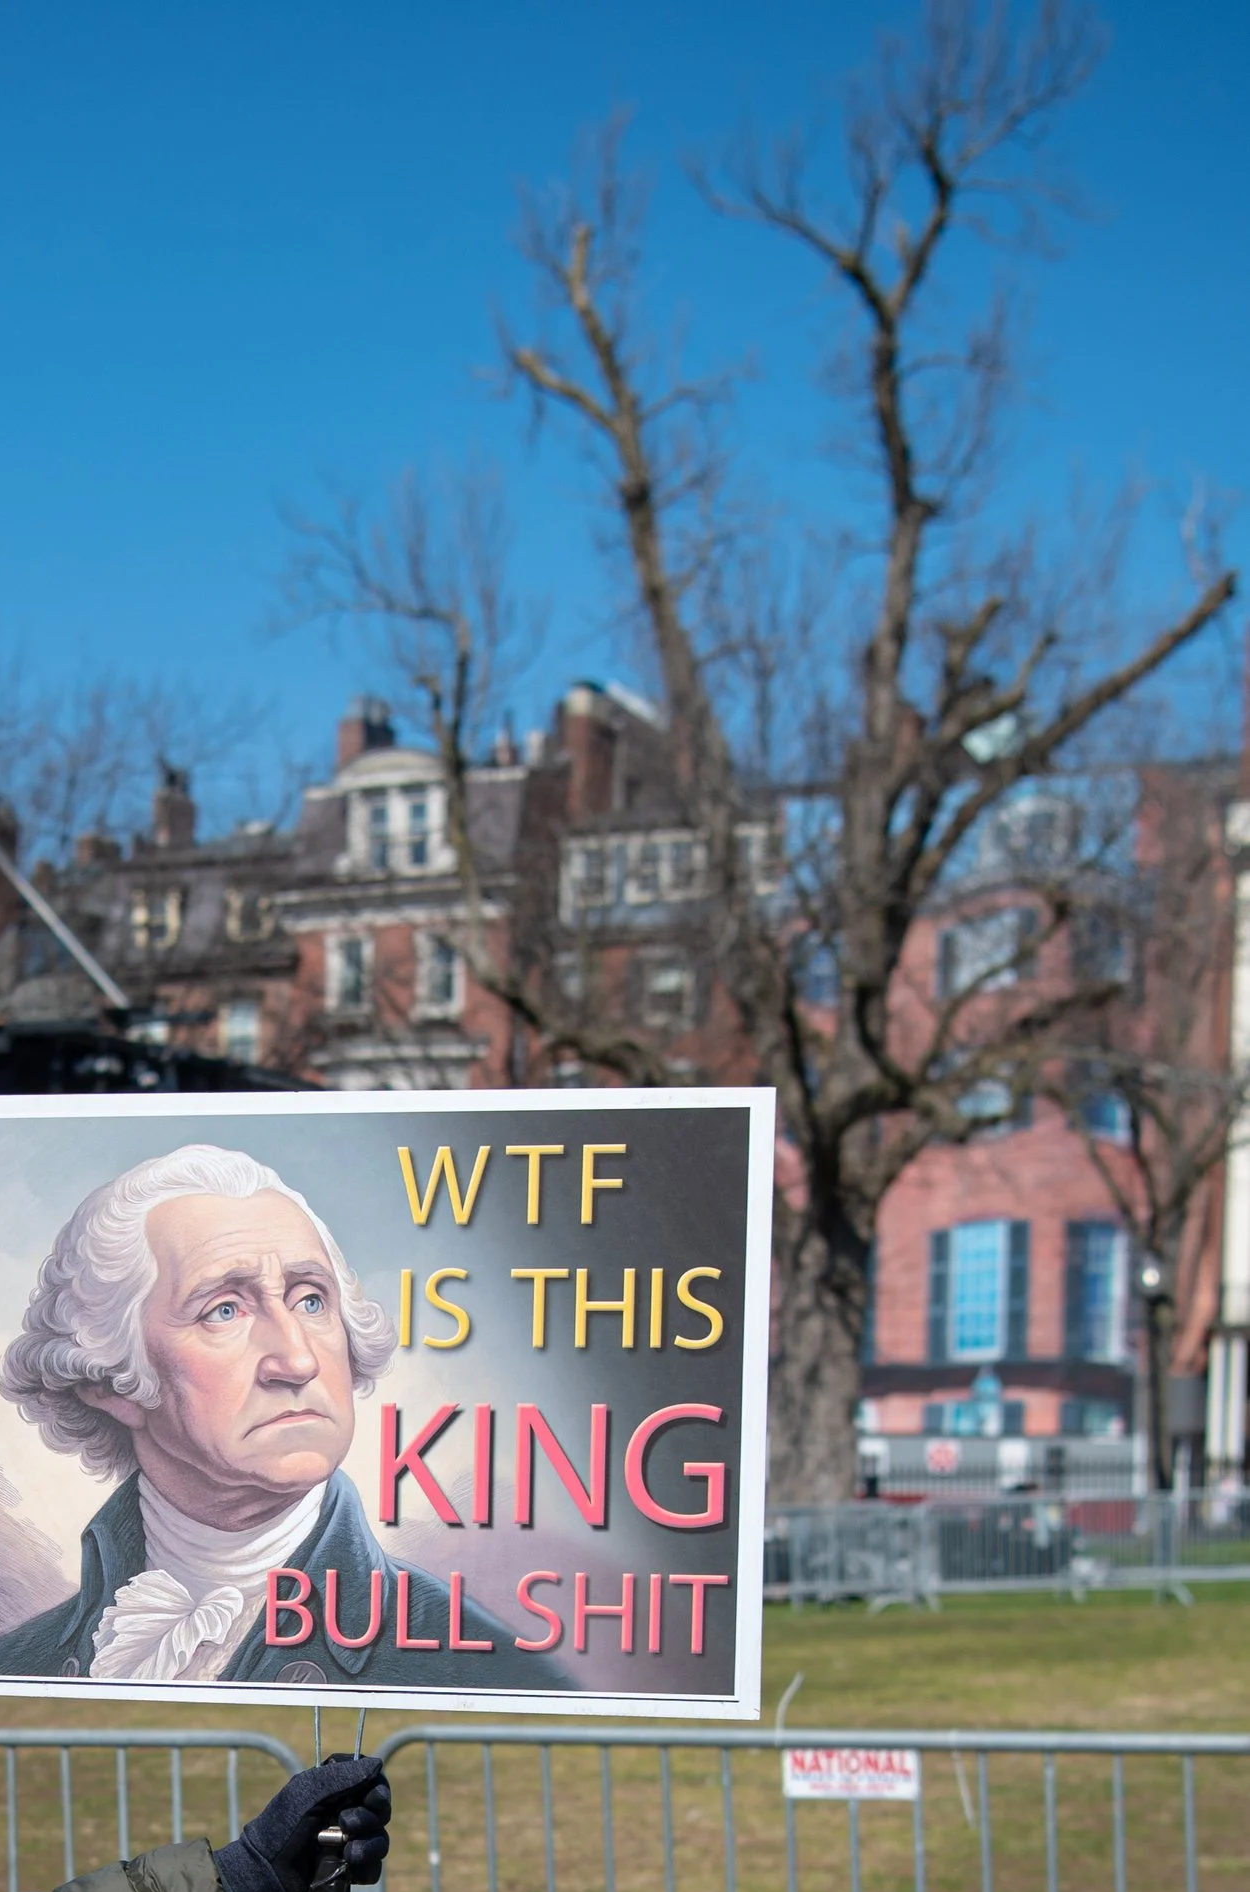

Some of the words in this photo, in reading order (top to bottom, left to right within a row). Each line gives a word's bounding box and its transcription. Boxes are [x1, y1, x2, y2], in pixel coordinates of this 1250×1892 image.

[398, 1144, 627, 1226] WTF
[399, 1269, 471, 1349] IS
[510, 1267, 724, 1350] THIS
[378, 1403, 727, 1528] KING
[790, 1749, 912, 1778] NATIONAL
